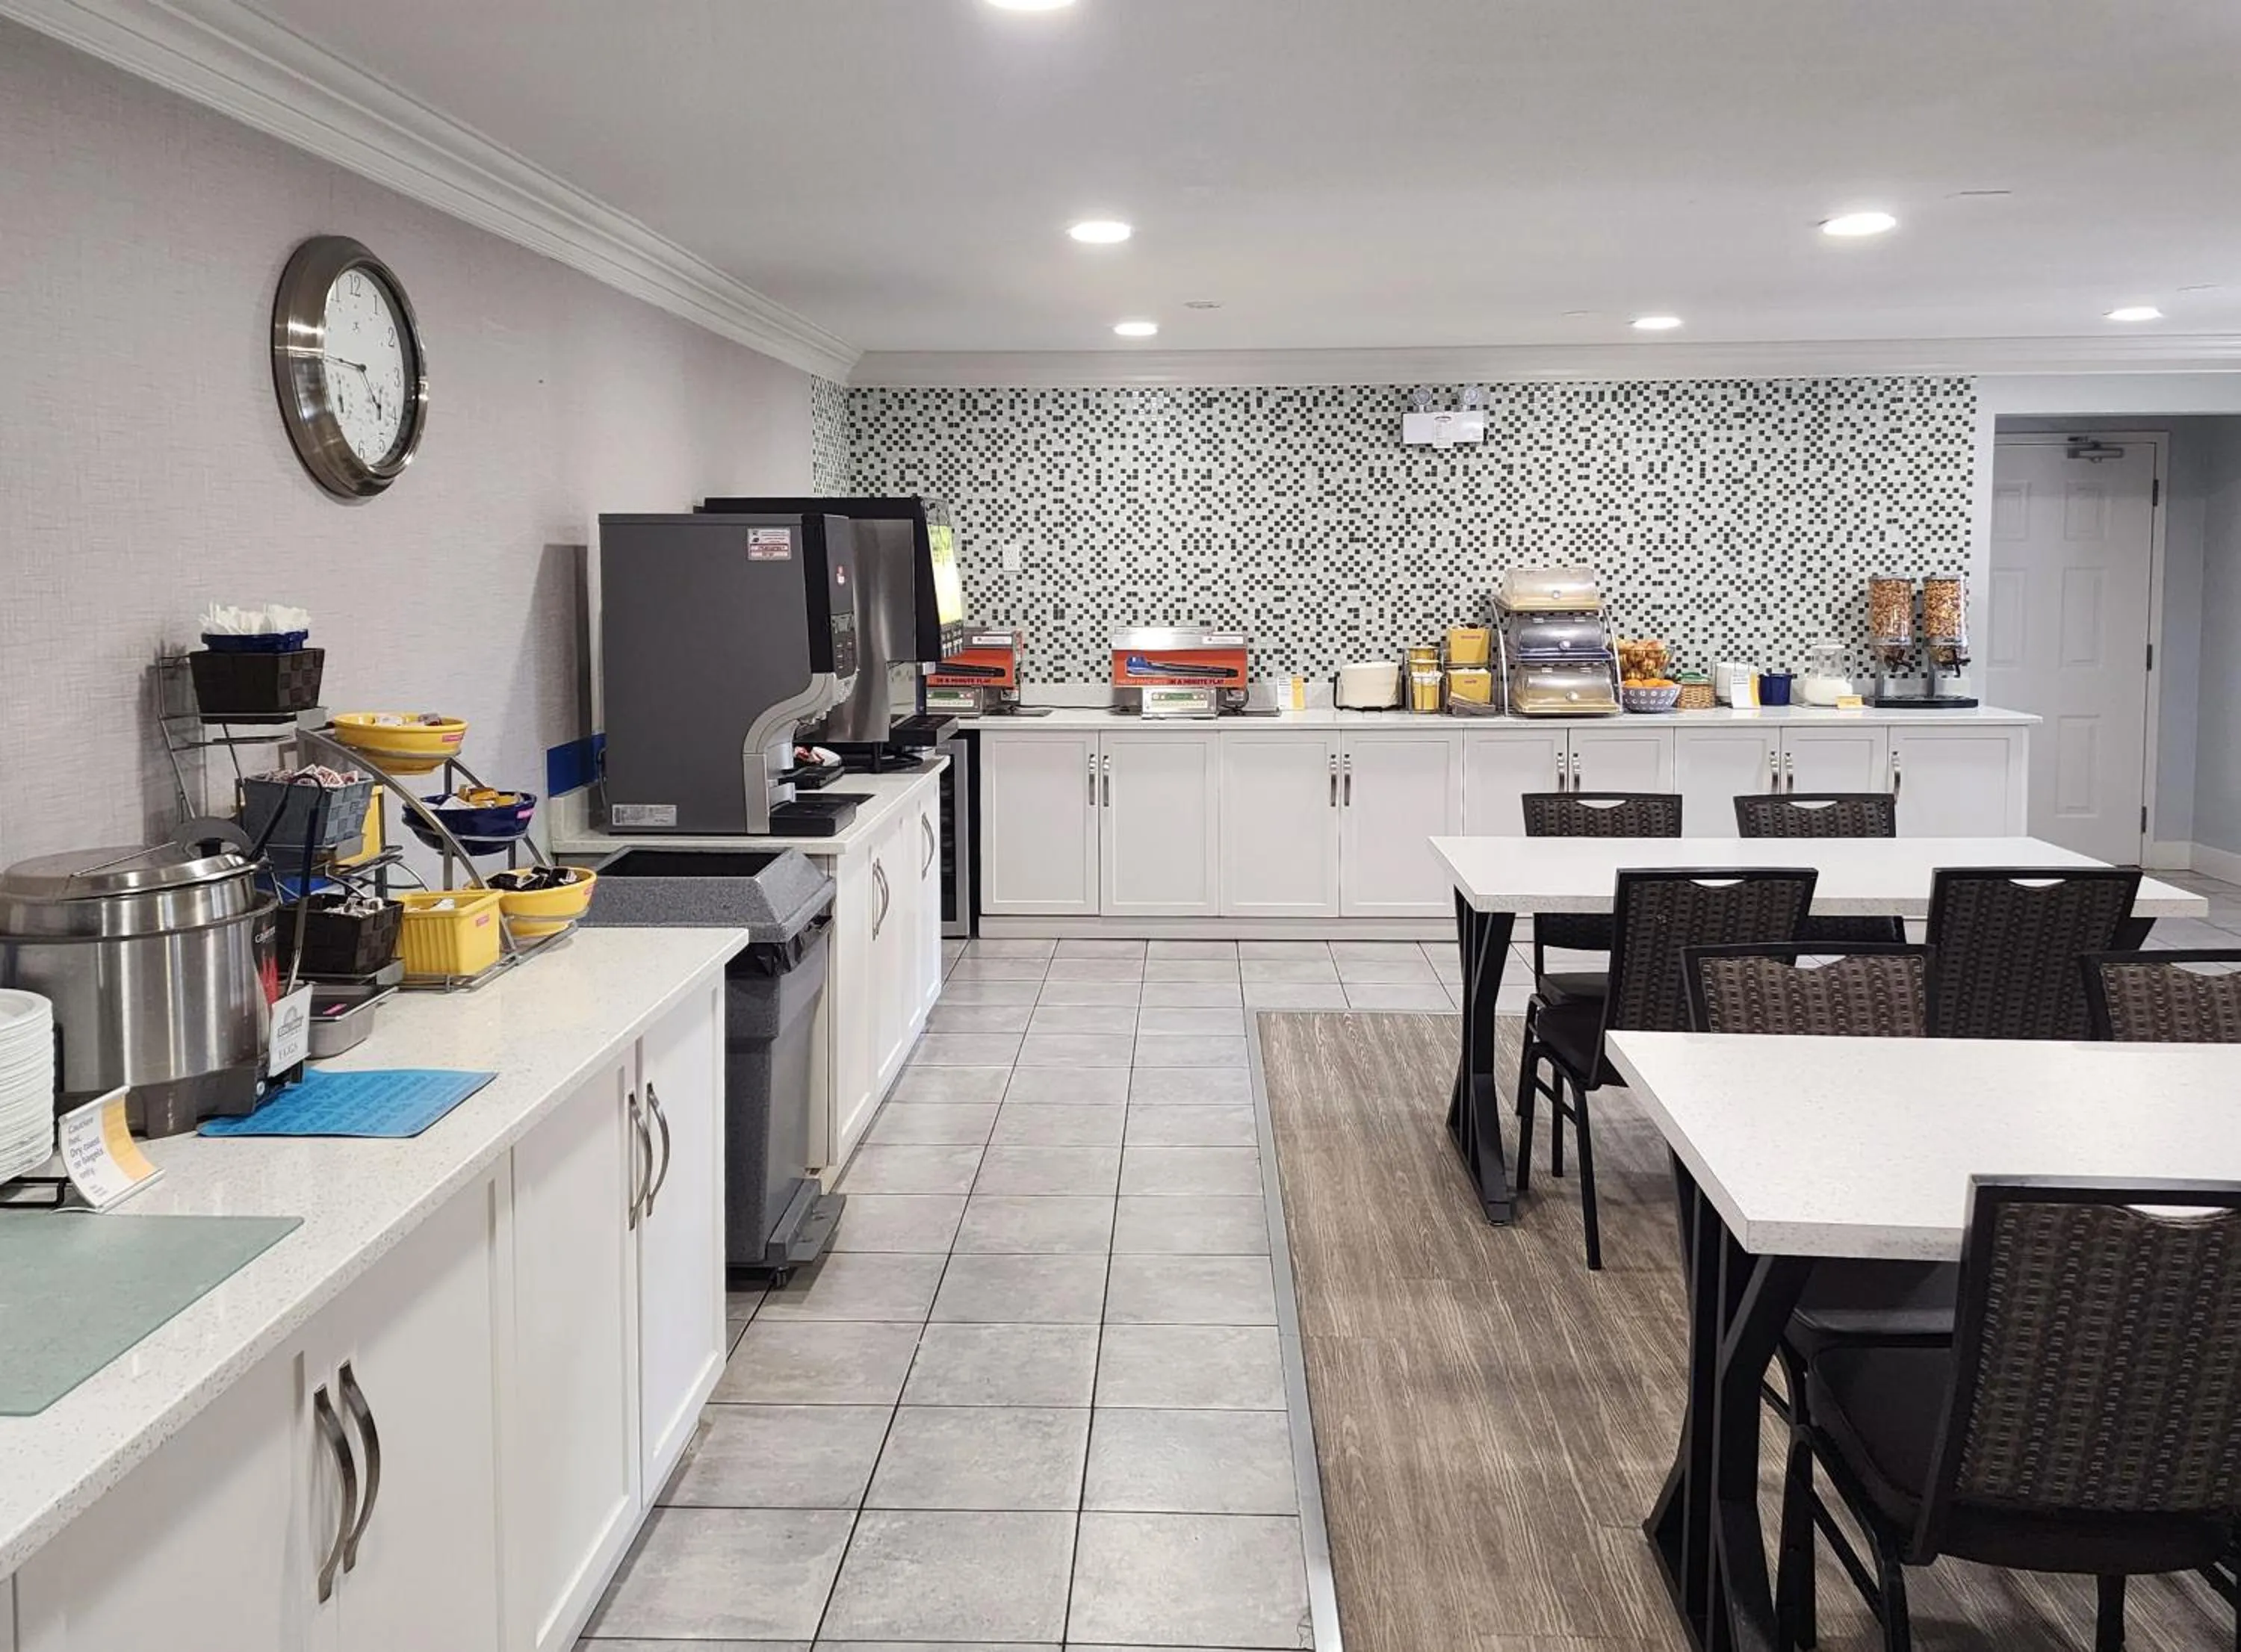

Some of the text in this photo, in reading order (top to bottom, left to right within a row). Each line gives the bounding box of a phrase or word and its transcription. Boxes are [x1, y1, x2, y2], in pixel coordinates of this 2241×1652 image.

[349, 273, 361, 297] 12
[374, 294, 379, 315] 1
[388, 326, 395, 348] 2
[394, 367, 401, 388] 3
[379, 432, 385, 453] 5
